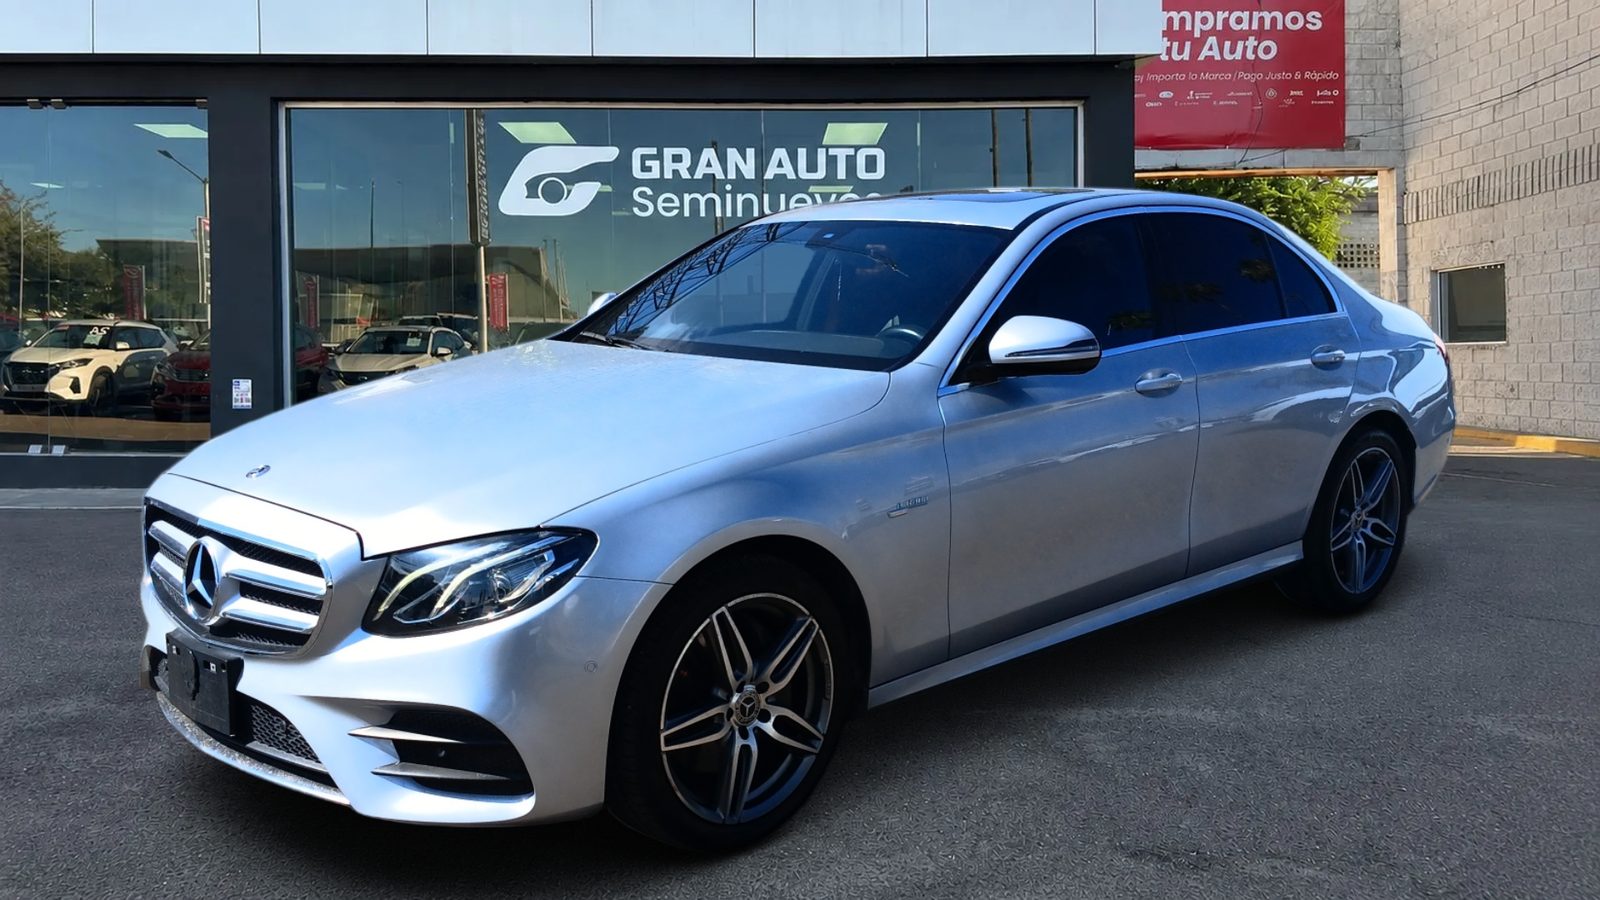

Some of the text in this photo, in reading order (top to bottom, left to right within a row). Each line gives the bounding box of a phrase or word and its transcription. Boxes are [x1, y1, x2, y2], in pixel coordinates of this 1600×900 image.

[1160, 36, 1278, 61] tu Auto
[1146, 73, 1186, 83] Importa
[1199, 72, 1232, 80] Marca
[1265, 71, 1293, 80] Justo
[1304, 70, 1339, 82] Rápido
[632, 147, 886, 180] GRAN AUTO
[632, 184, 882, 218] Seminue
